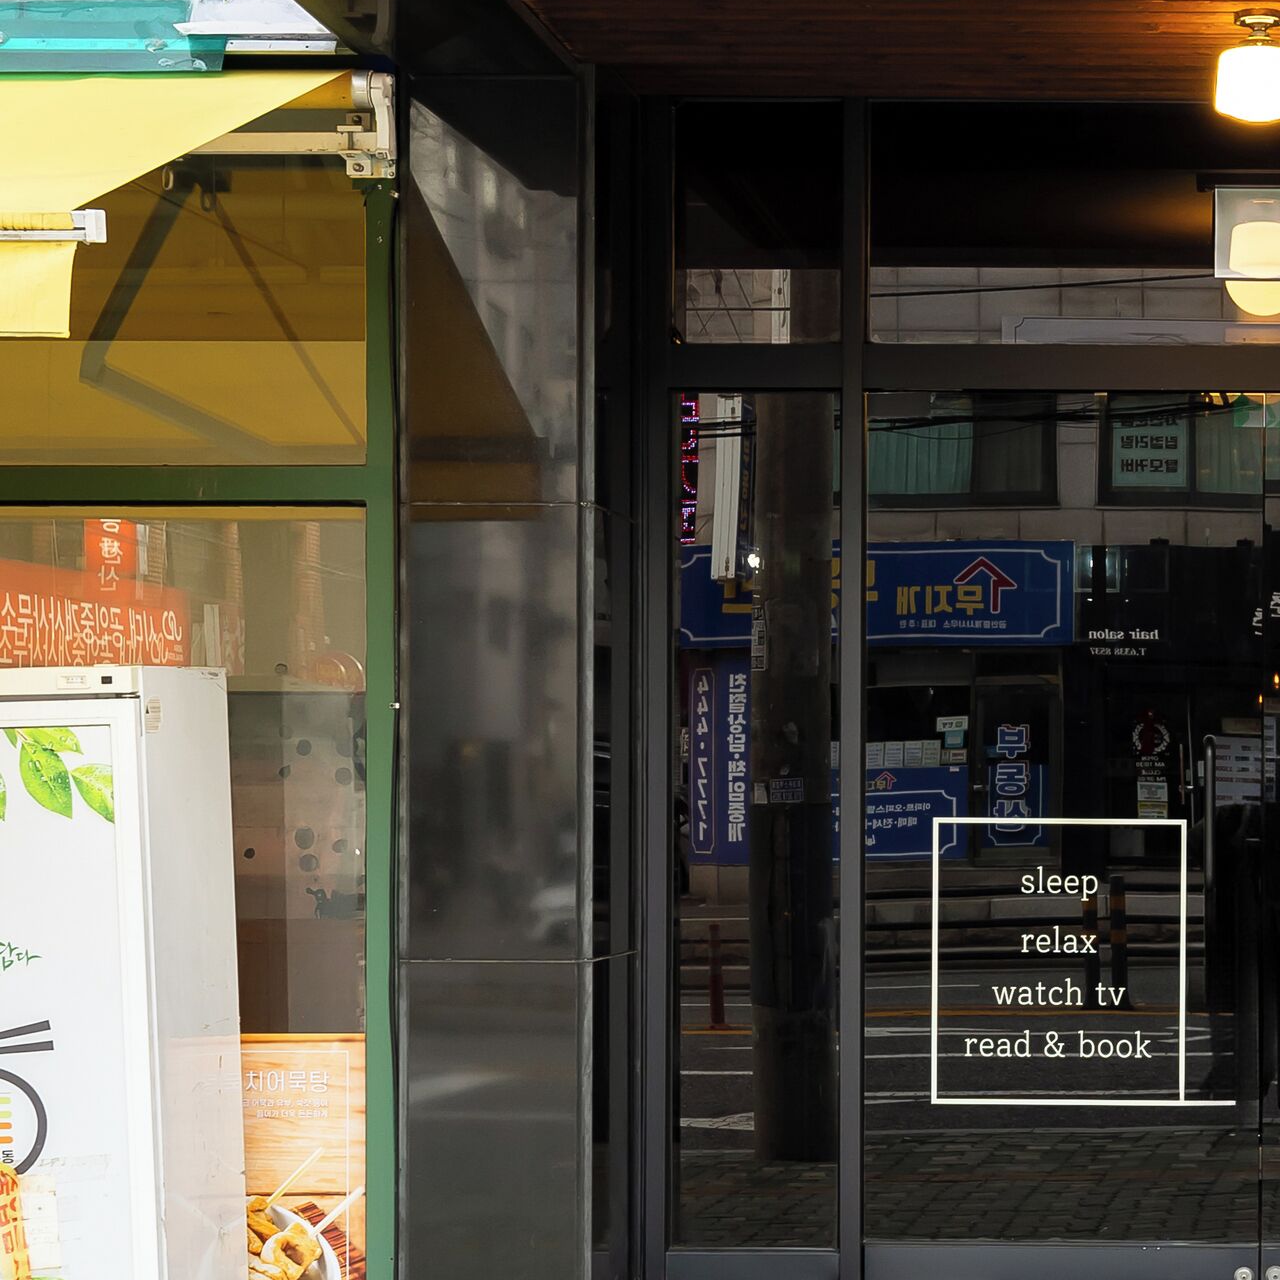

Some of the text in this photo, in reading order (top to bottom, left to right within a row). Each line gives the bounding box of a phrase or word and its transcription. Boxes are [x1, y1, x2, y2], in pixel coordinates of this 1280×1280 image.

[1020, 866, 1098, 901] sleep
[1020, 925, 1097, 954] relax
[992, 977, 1126, 1006] watch tv
[963, 1030, 1152, 1058] read & book
